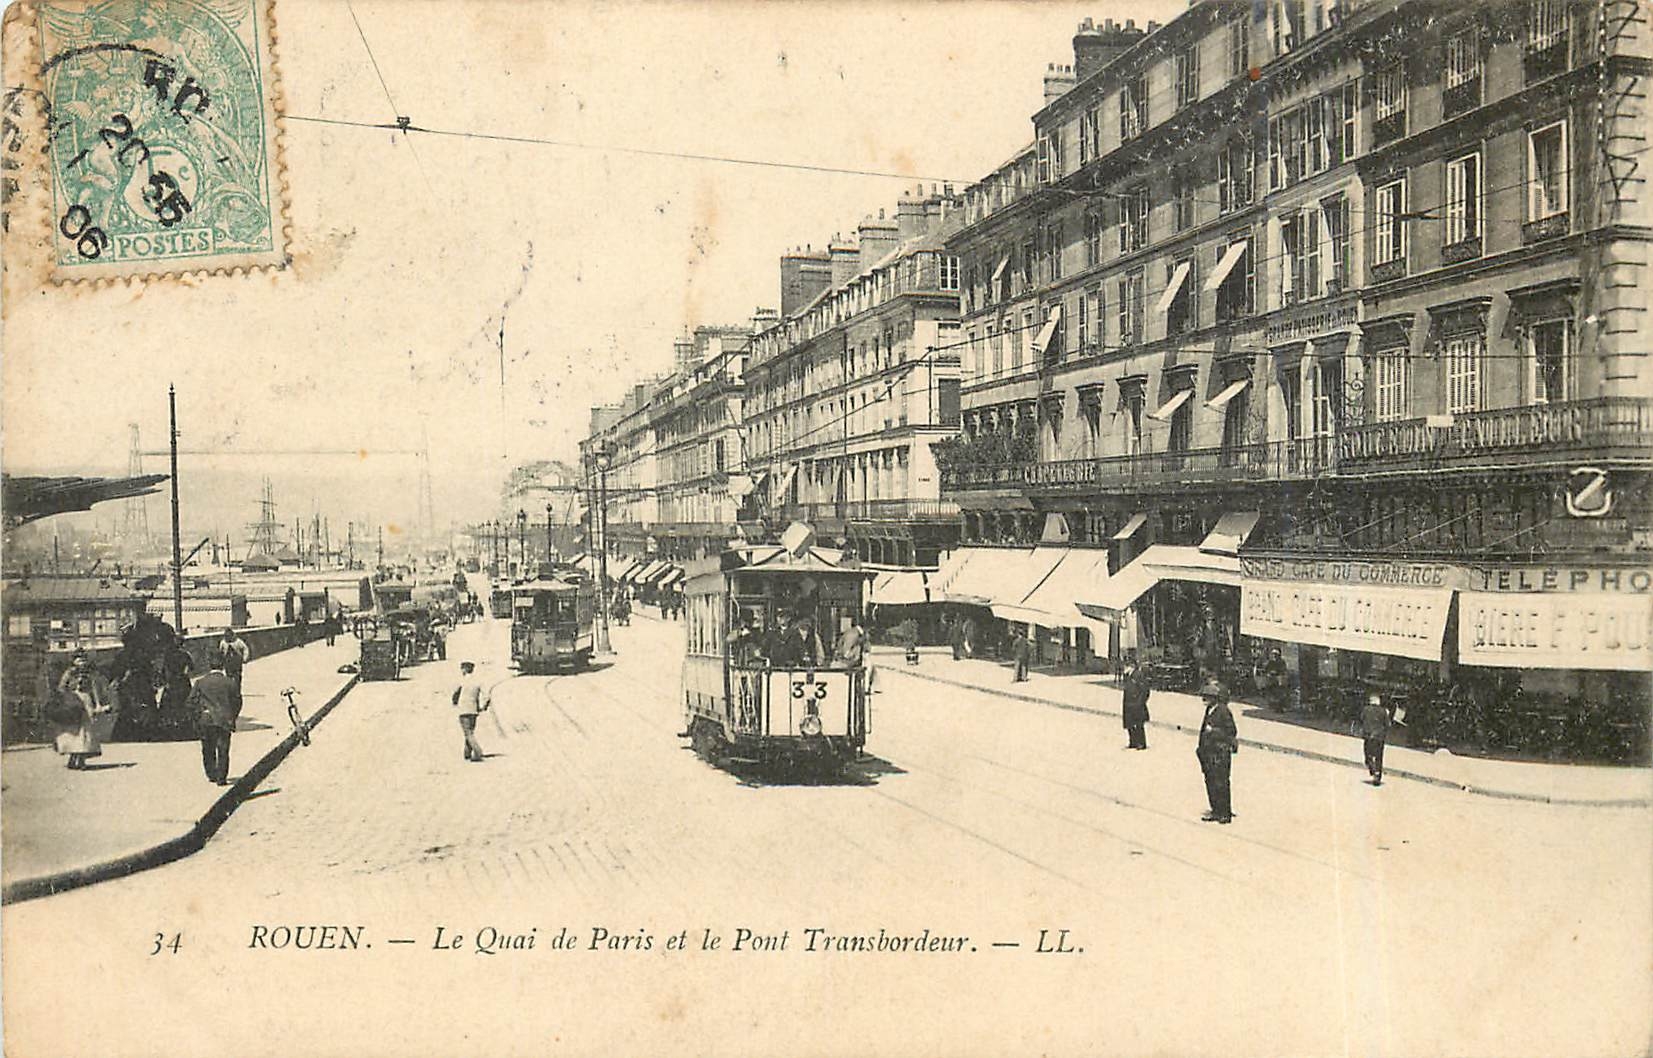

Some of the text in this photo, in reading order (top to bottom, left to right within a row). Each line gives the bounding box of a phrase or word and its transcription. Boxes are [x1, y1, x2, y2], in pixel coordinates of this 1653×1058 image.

[119, 231, 210, 258] POSTES
[1332, 564, 1351, 580] DU
[1359, 565, 1444, 585] COMMERCE
[792, 681, 828, 699] 33
